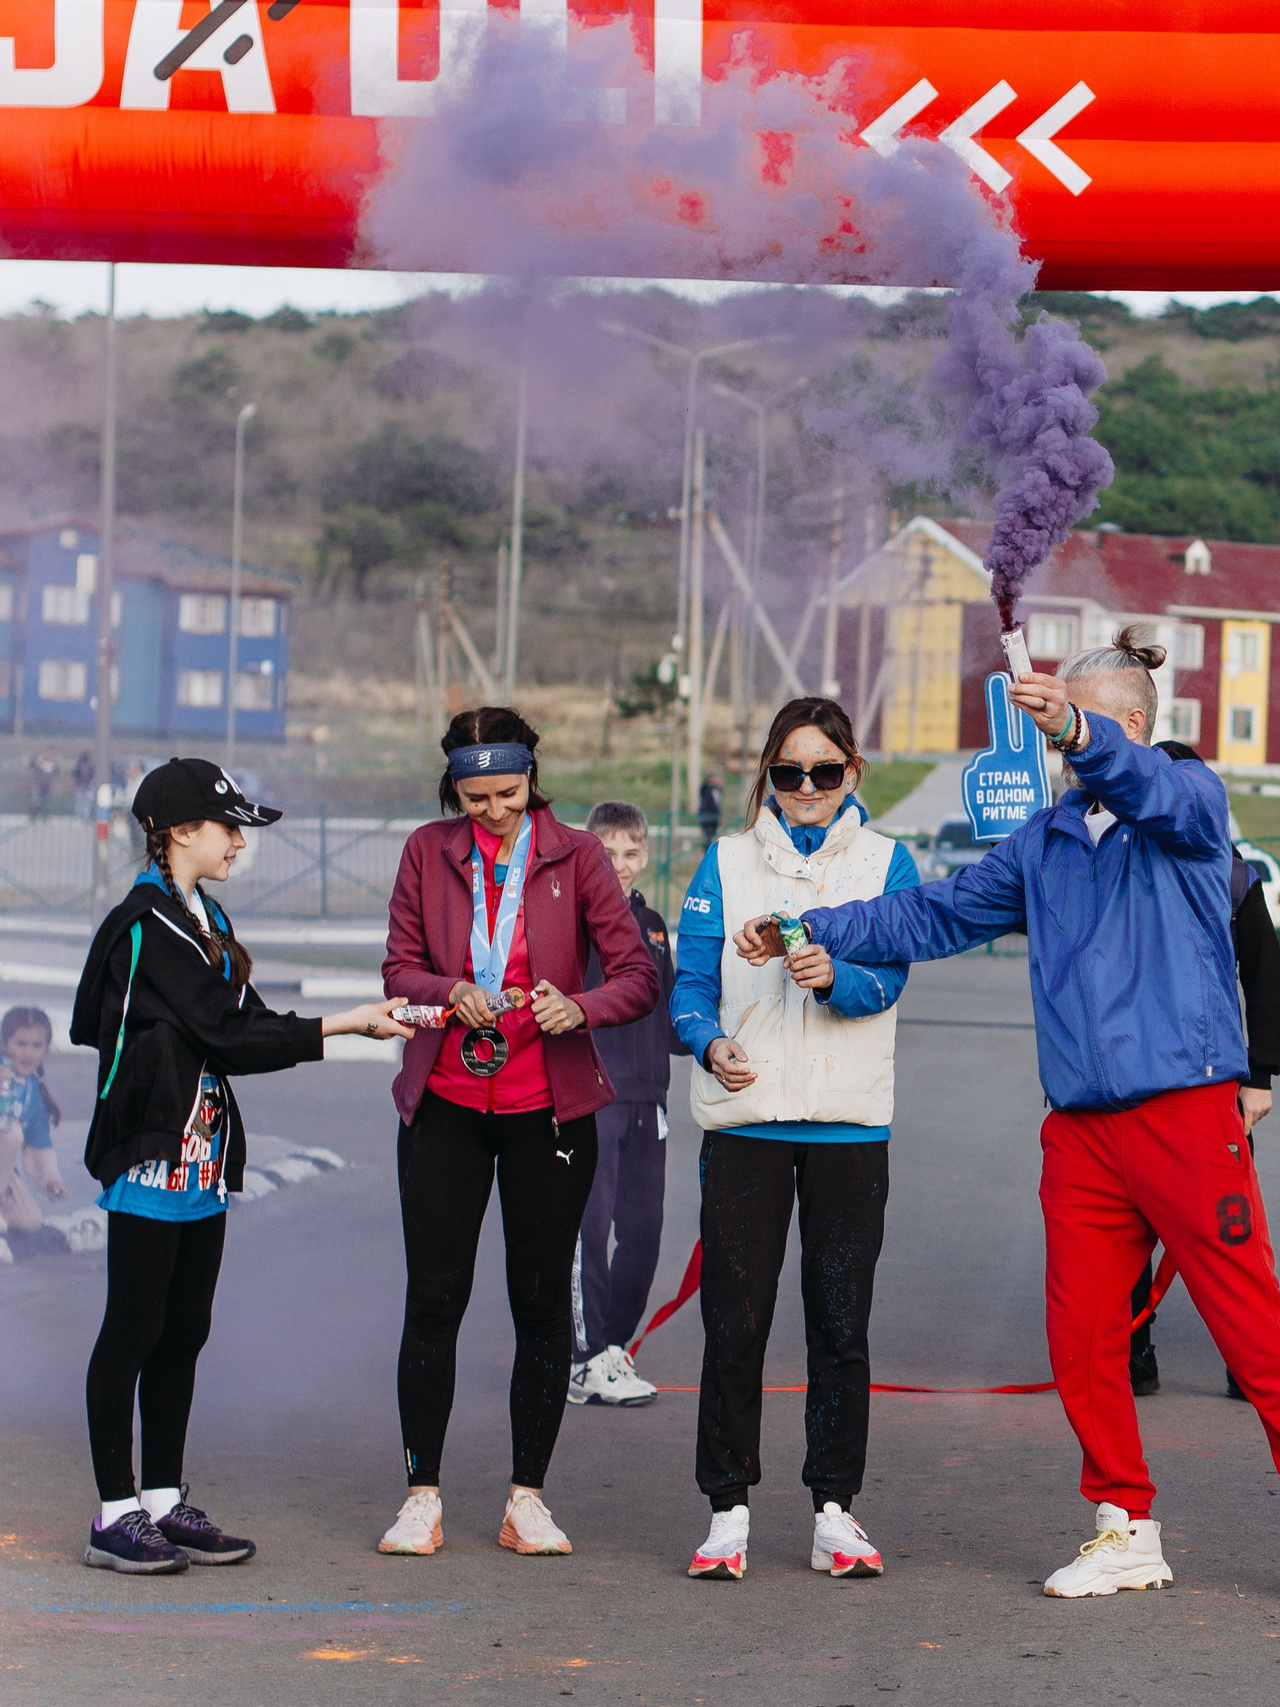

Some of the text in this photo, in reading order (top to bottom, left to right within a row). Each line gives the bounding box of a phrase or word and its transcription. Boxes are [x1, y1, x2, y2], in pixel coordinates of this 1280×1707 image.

[979, 771, 1031, 787] СТРАНА
[976, 788, 1035, 805] В ОДНОМ
[982, 805, 1027, 821] РИТМЕ
[1215, 1193, 1252, 1247] 8
